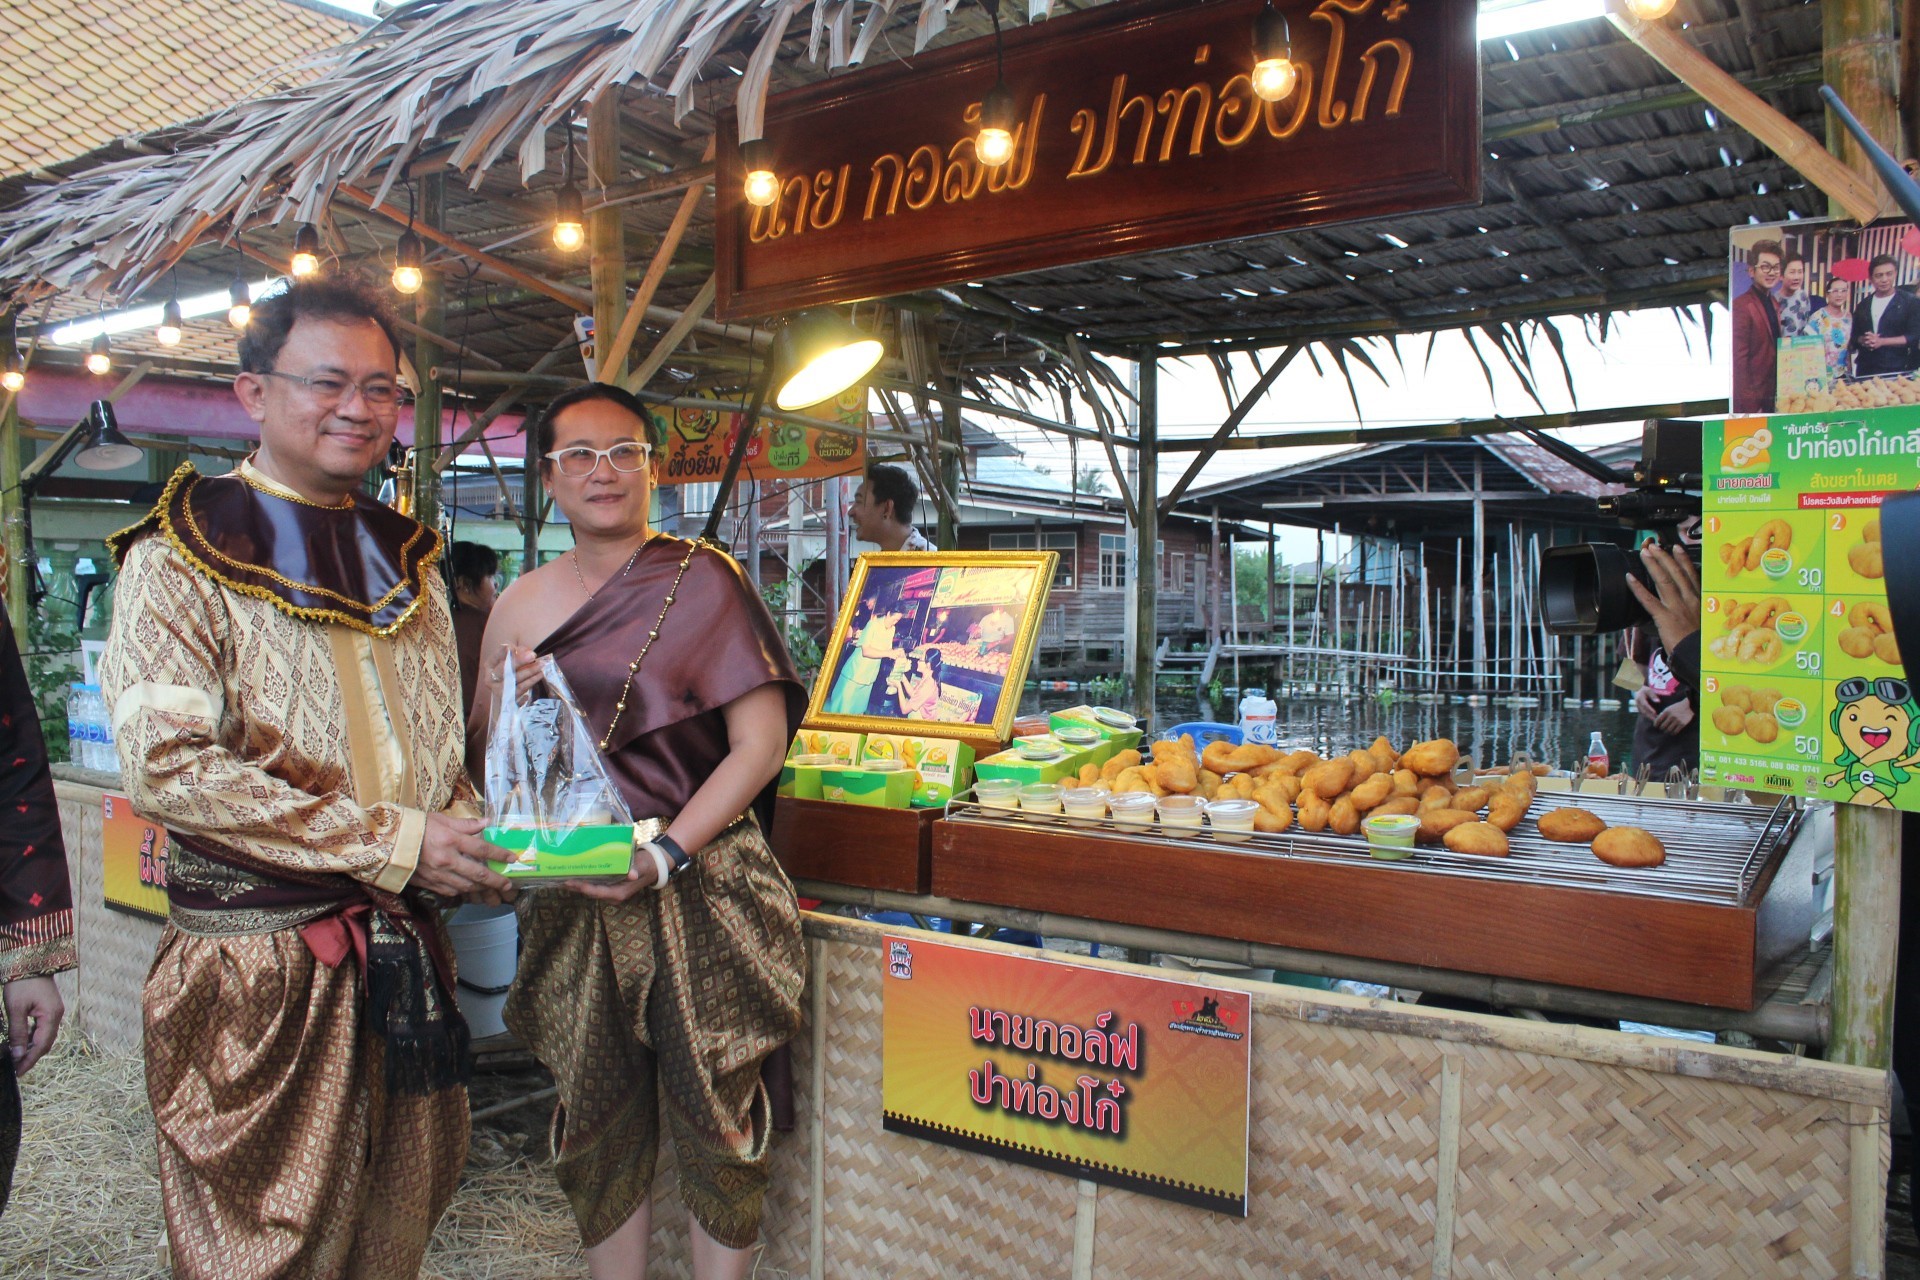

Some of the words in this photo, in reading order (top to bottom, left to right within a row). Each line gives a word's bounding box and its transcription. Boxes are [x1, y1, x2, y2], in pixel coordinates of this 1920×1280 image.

[1717, 474, 1772, 489] นายกอล์ฟ
[1708, 518, 1716, 532] 1
[1831, 514, 1842, 530] 2
[1798, 568, 1822, 587] 30
[1706, 597, 1716, 613] 3
[1830, 600, 1842, 617] 4
[1796, 651, 1821, 670] 50
[1706, 677, 1716, 693] 5
[1794, 736, 1819, 754] 50
[969, 1007, 1138, 1071] นายกอล์ฟ
[969, 1060, 1125, 1134] ปาท่องโก๋
